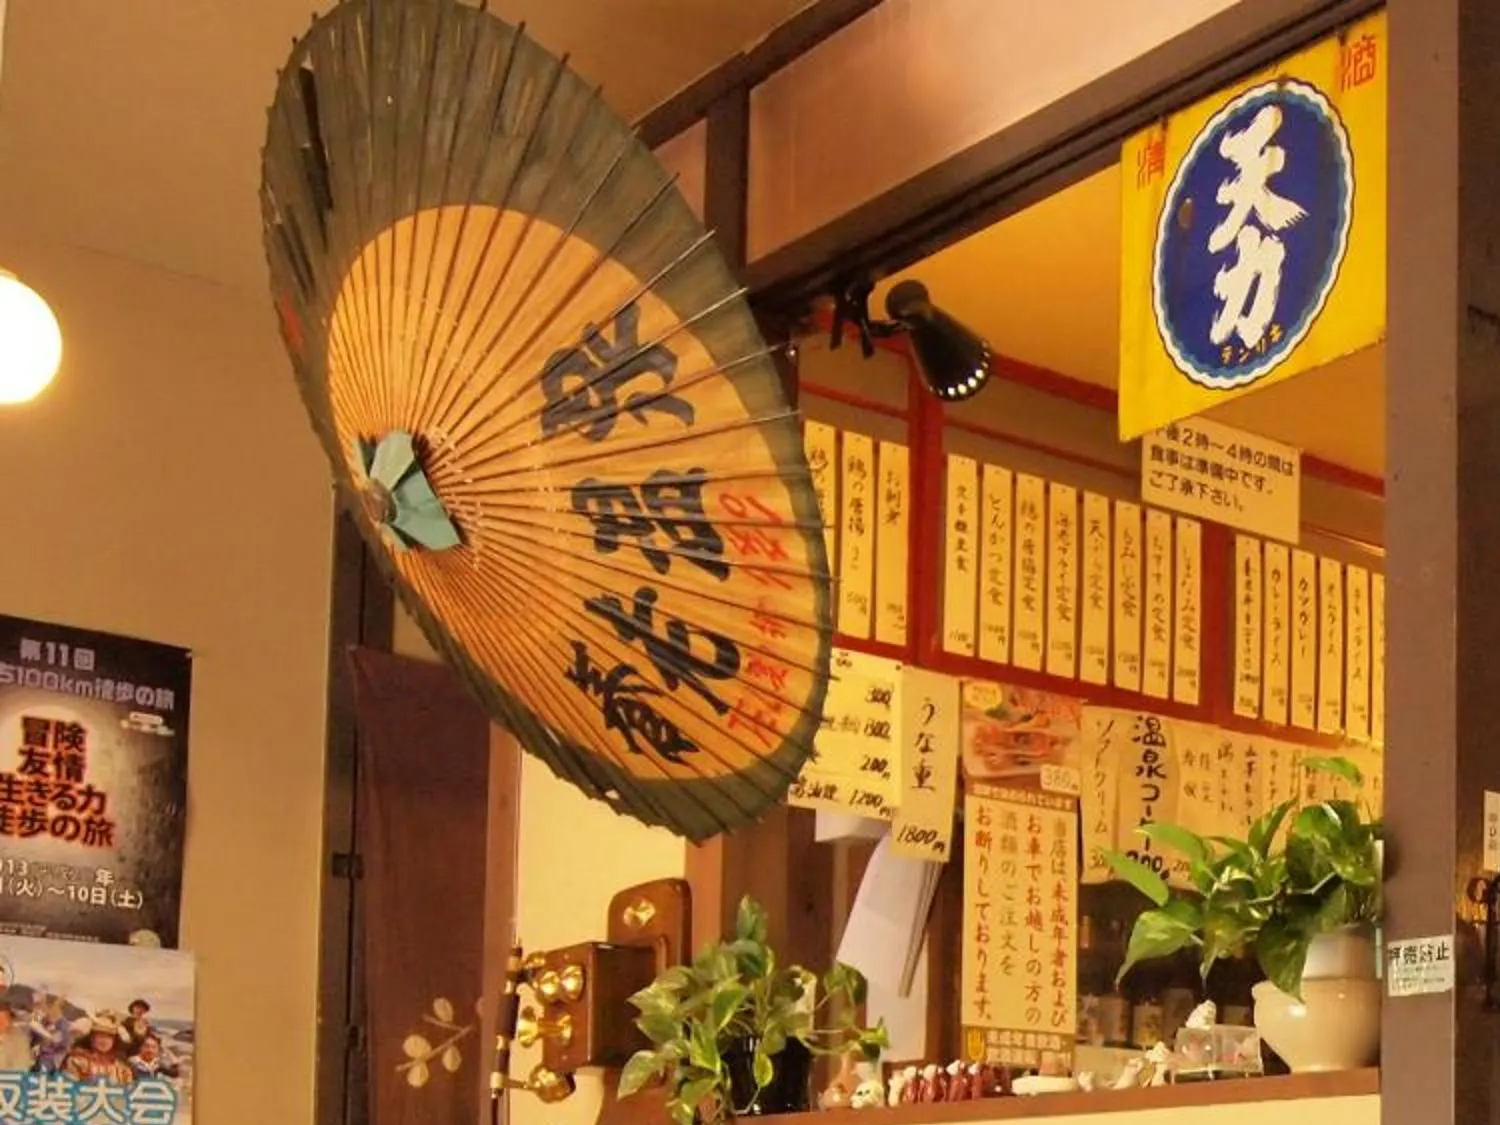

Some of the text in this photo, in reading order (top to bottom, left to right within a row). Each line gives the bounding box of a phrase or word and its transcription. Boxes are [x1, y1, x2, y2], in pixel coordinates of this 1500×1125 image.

[1208, 103, 1310, 351] 天力
[18, 746, 86, 783] 友情
[21, 717, 87, 753] 冒険
[910, 697, 937, 792] うな重
[0, 772, 107, 816] 生きる力
[973, 806, 993, 1021] お断りしております。
[1024, 813, 1045, 1025] お車でお越しの方の
